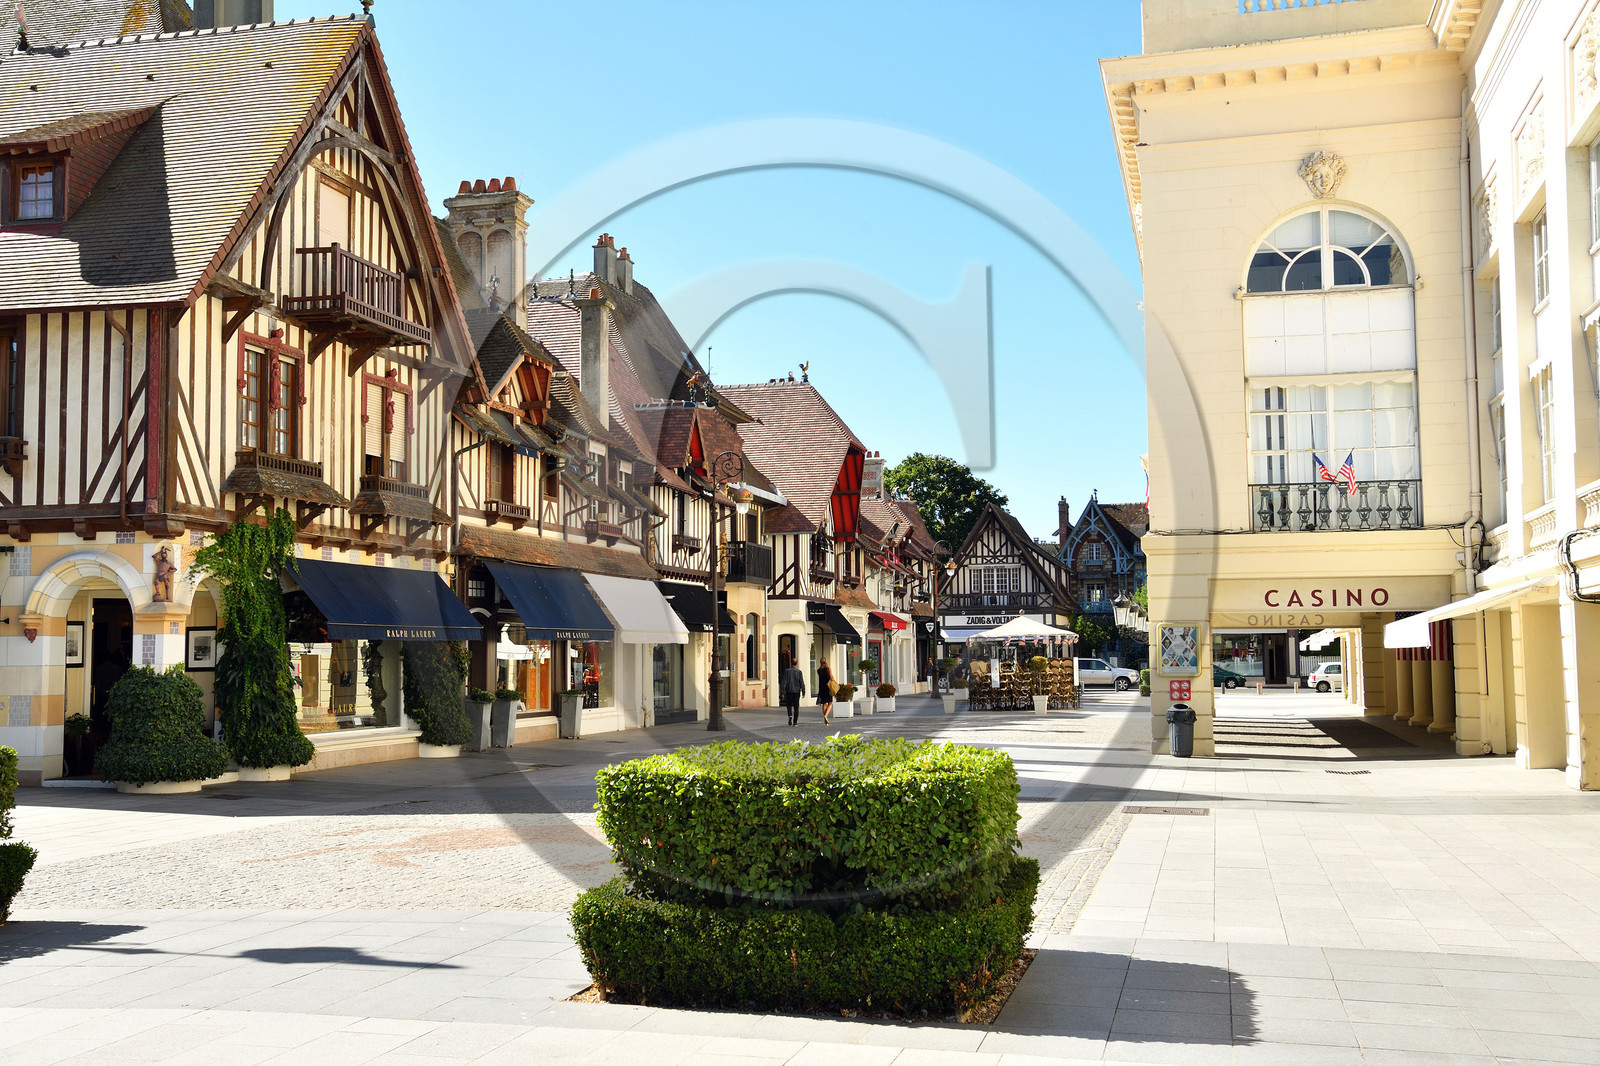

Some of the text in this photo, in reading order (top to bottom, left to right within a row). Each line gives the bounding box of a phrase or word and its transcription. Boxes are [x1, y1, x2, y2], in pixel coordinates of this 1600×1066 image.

[1263, 588, 1389, 607] CASINO
[386, 629, 436, 638] RALPH LAUREN
